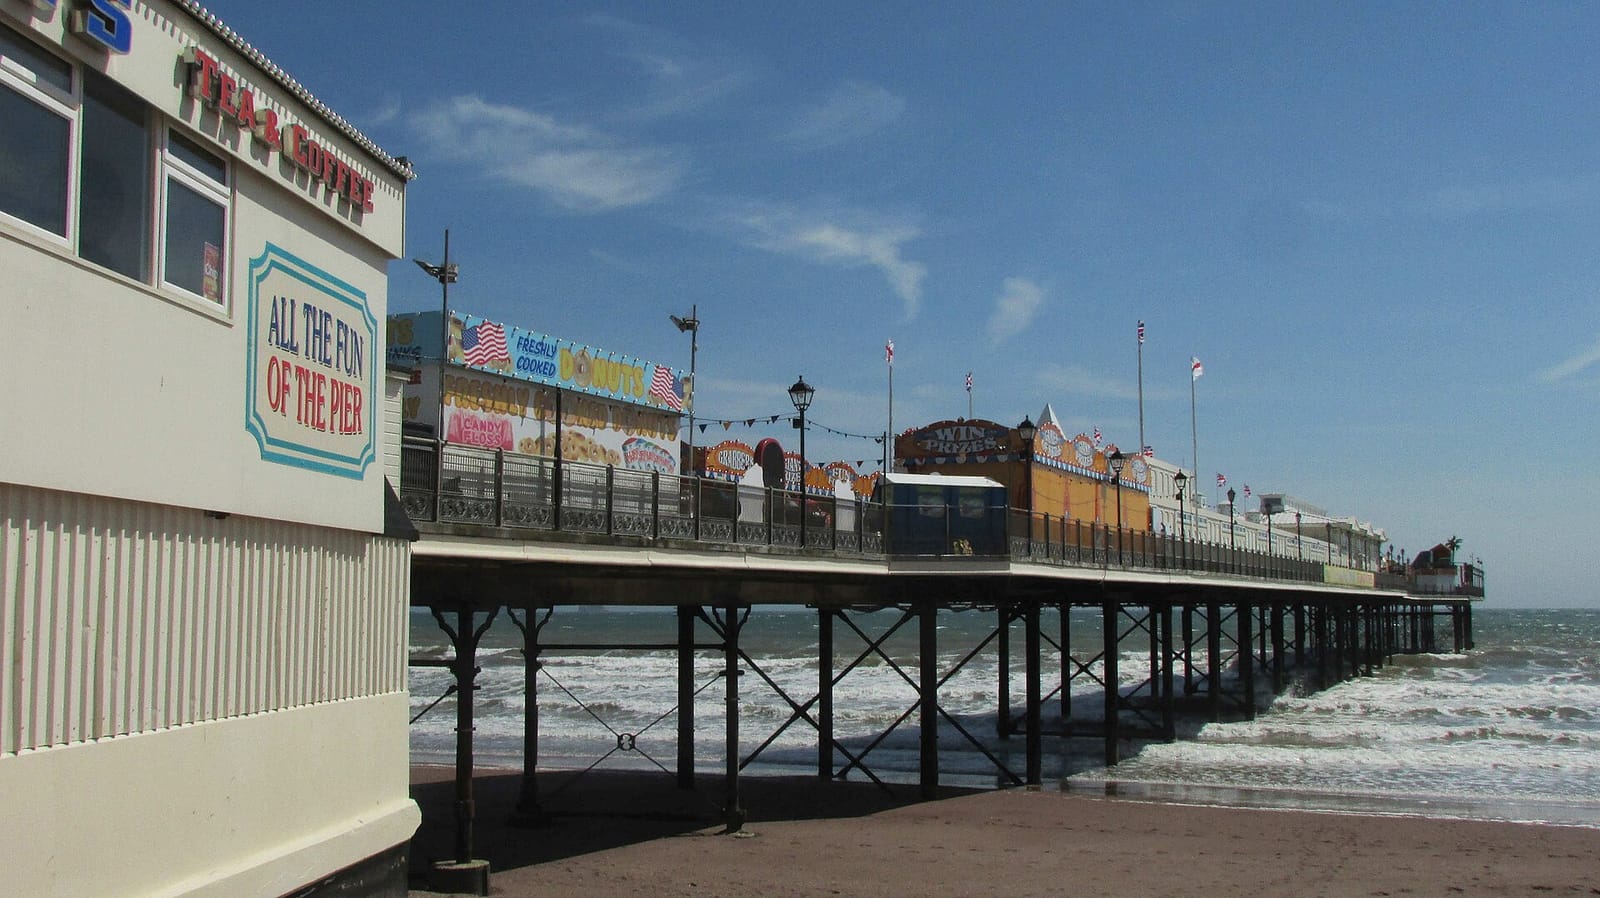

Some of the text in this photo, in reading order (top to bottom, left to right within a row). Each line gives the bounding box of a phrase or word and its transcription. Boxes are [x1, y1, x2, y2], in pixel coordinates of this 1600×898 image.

[193, 48, 375, 214] TEA & COFFEE
[268, 295, 364, 381] ALL THE FUN
[516, 335, 558, 359] FRESHLY
[516, 355, 557, 378] COOKED
[559, 348, 645, 399] DONUTS
[267, 355, 363, 435] OF THE PIER
[462, 417, 502, 433] CANDY
[934, 426, 986, 441] WIN
[461, 430, 503, 446] FLOSS
[925, 437, 998, 454] PRIZES
